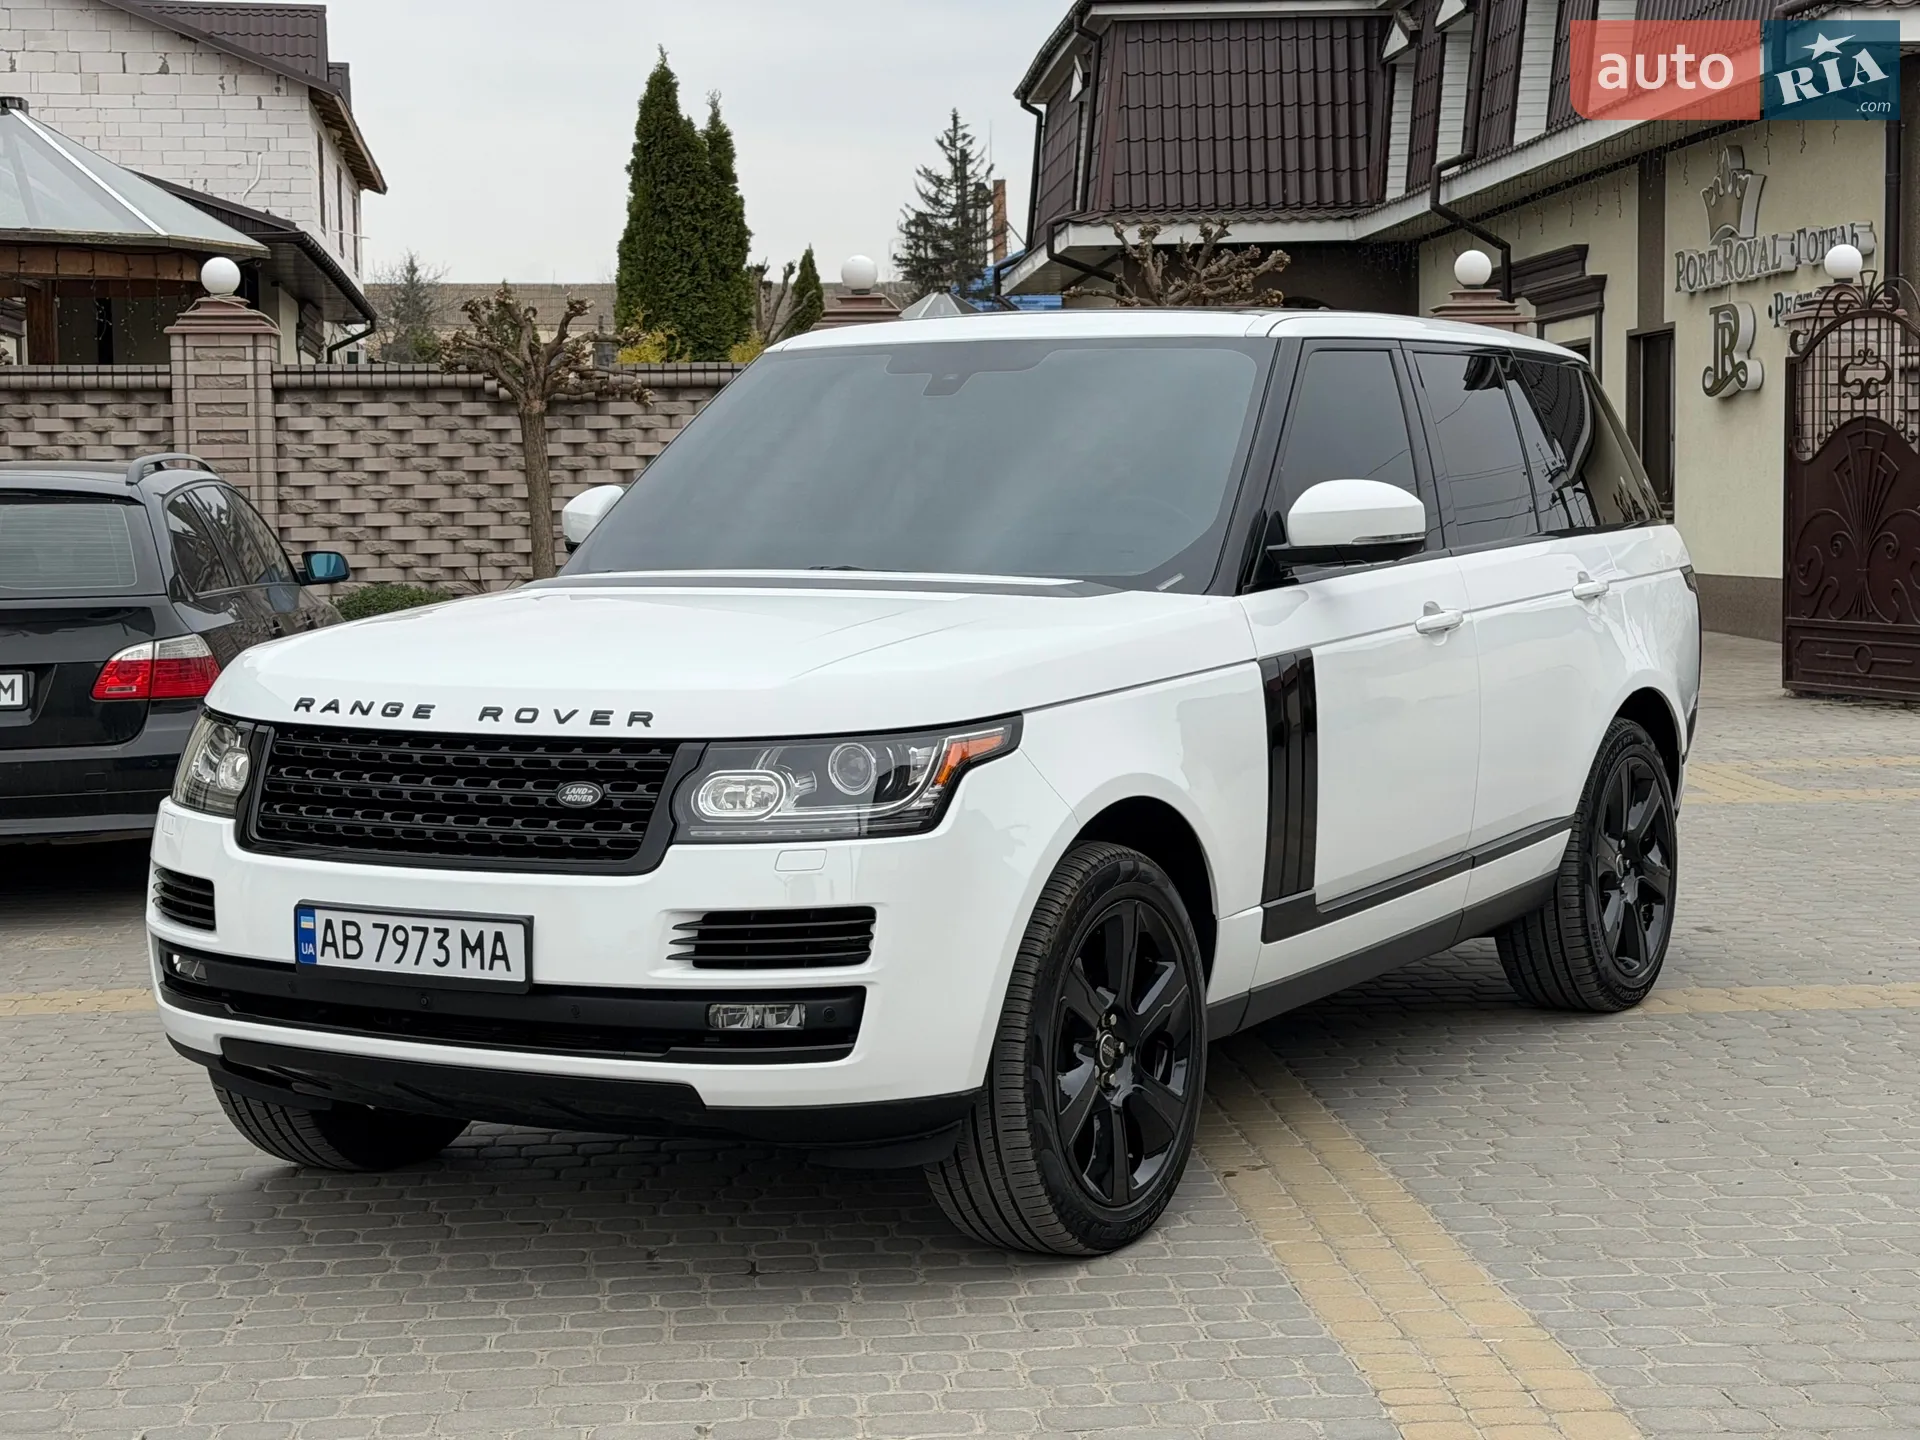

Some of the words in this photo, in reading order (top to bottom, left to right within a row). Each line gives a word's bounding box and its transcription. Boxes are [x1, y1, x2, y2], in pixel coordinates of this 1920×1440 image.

[1675, 249, 1719, 293] PORT
[1721, 233, 1782, 283] ROYAL
[294, 697, 437, 720] RANGE
[478, 706, 655, 728] ROVER
[565, 787, 588, 795] LAND
[566, 794, 594, 802] ROVER
[301, 942, 316, 956] UA
[320, 918, 364, 960] AB
[372, 923, 451, 968] 7973
[460, 928, 512, 972] MA
